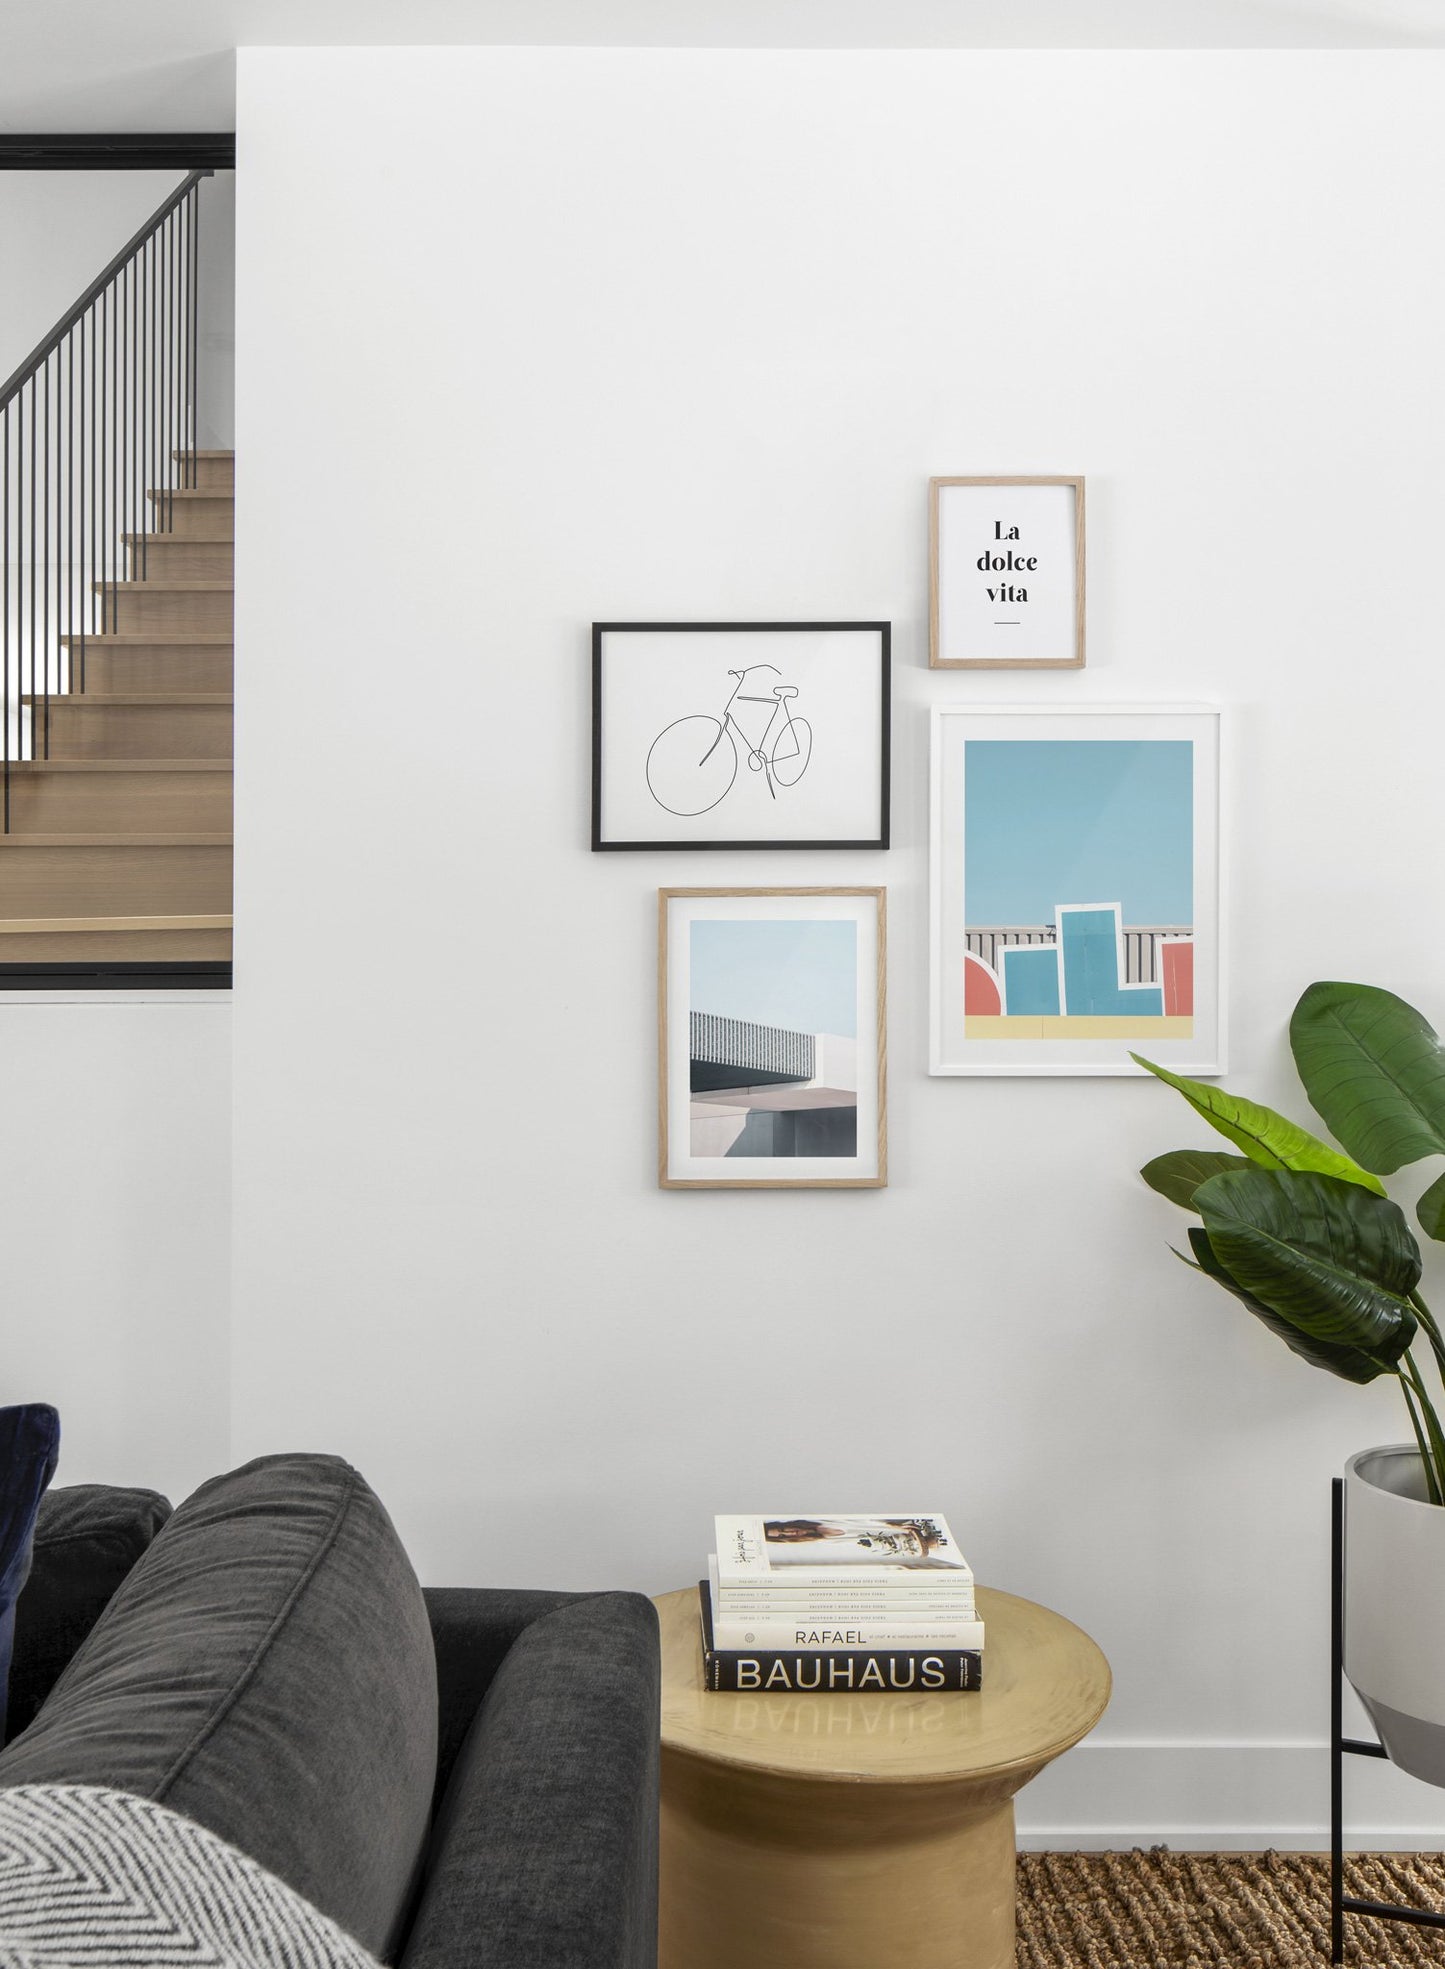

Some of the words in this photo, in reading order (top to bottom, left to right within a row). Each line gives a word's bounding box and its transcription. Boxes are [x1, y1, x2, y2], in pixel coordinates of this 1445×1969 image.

[994, 520, 1020, 540] La
[976, 550, 1038, 571] dolce
[985, 582, 1029, 602] vita
[795, 1631, 867, 1644] RAFAEL
[736, 1657, 946, 1689] BAUHAUS
